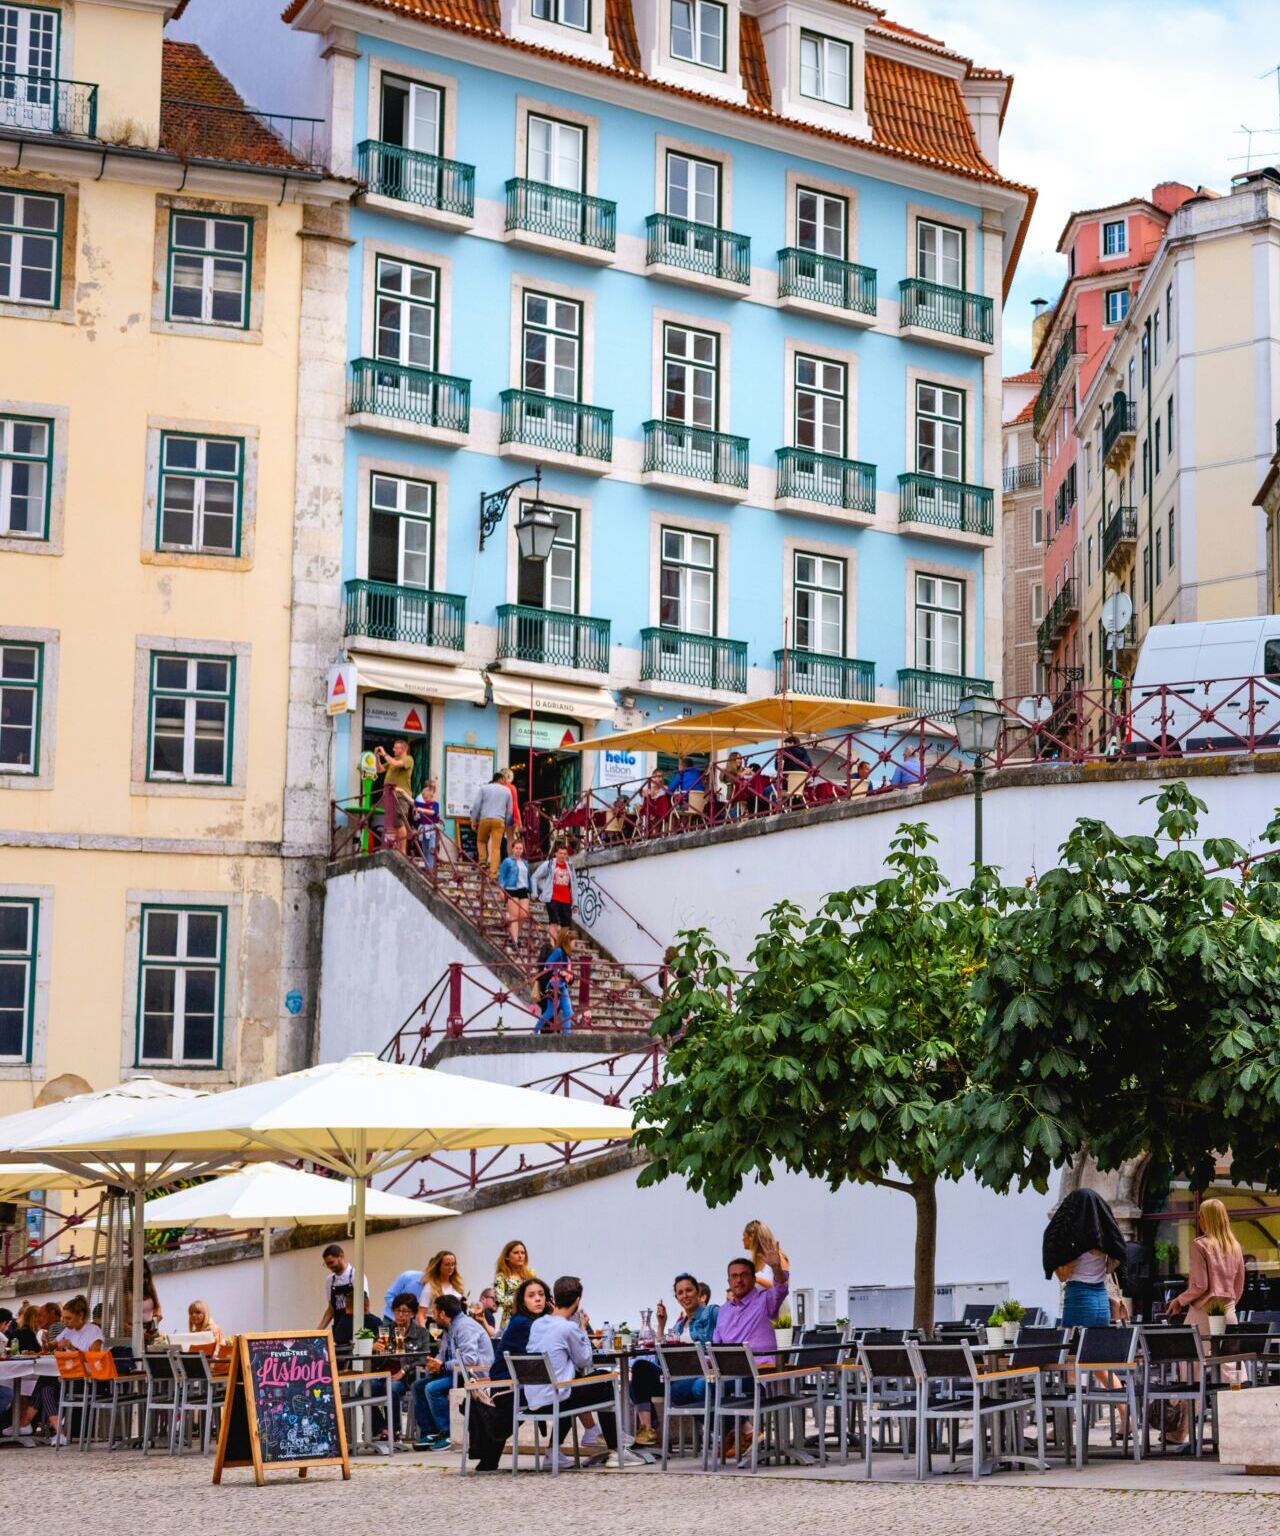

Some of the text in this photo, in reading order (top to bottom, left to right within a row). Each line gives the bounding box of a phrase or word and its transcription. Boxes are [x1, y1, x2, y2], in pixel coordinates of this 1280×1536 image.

[543, 701, 575, 712] ADRIANO
[605, 751, 636, 765] hello
[605, 764, 632, 775] Lisbon
[270, 1350, 309, 1358] FEVER-TREE
[256, 1355, 333, 1389] Lisbon
